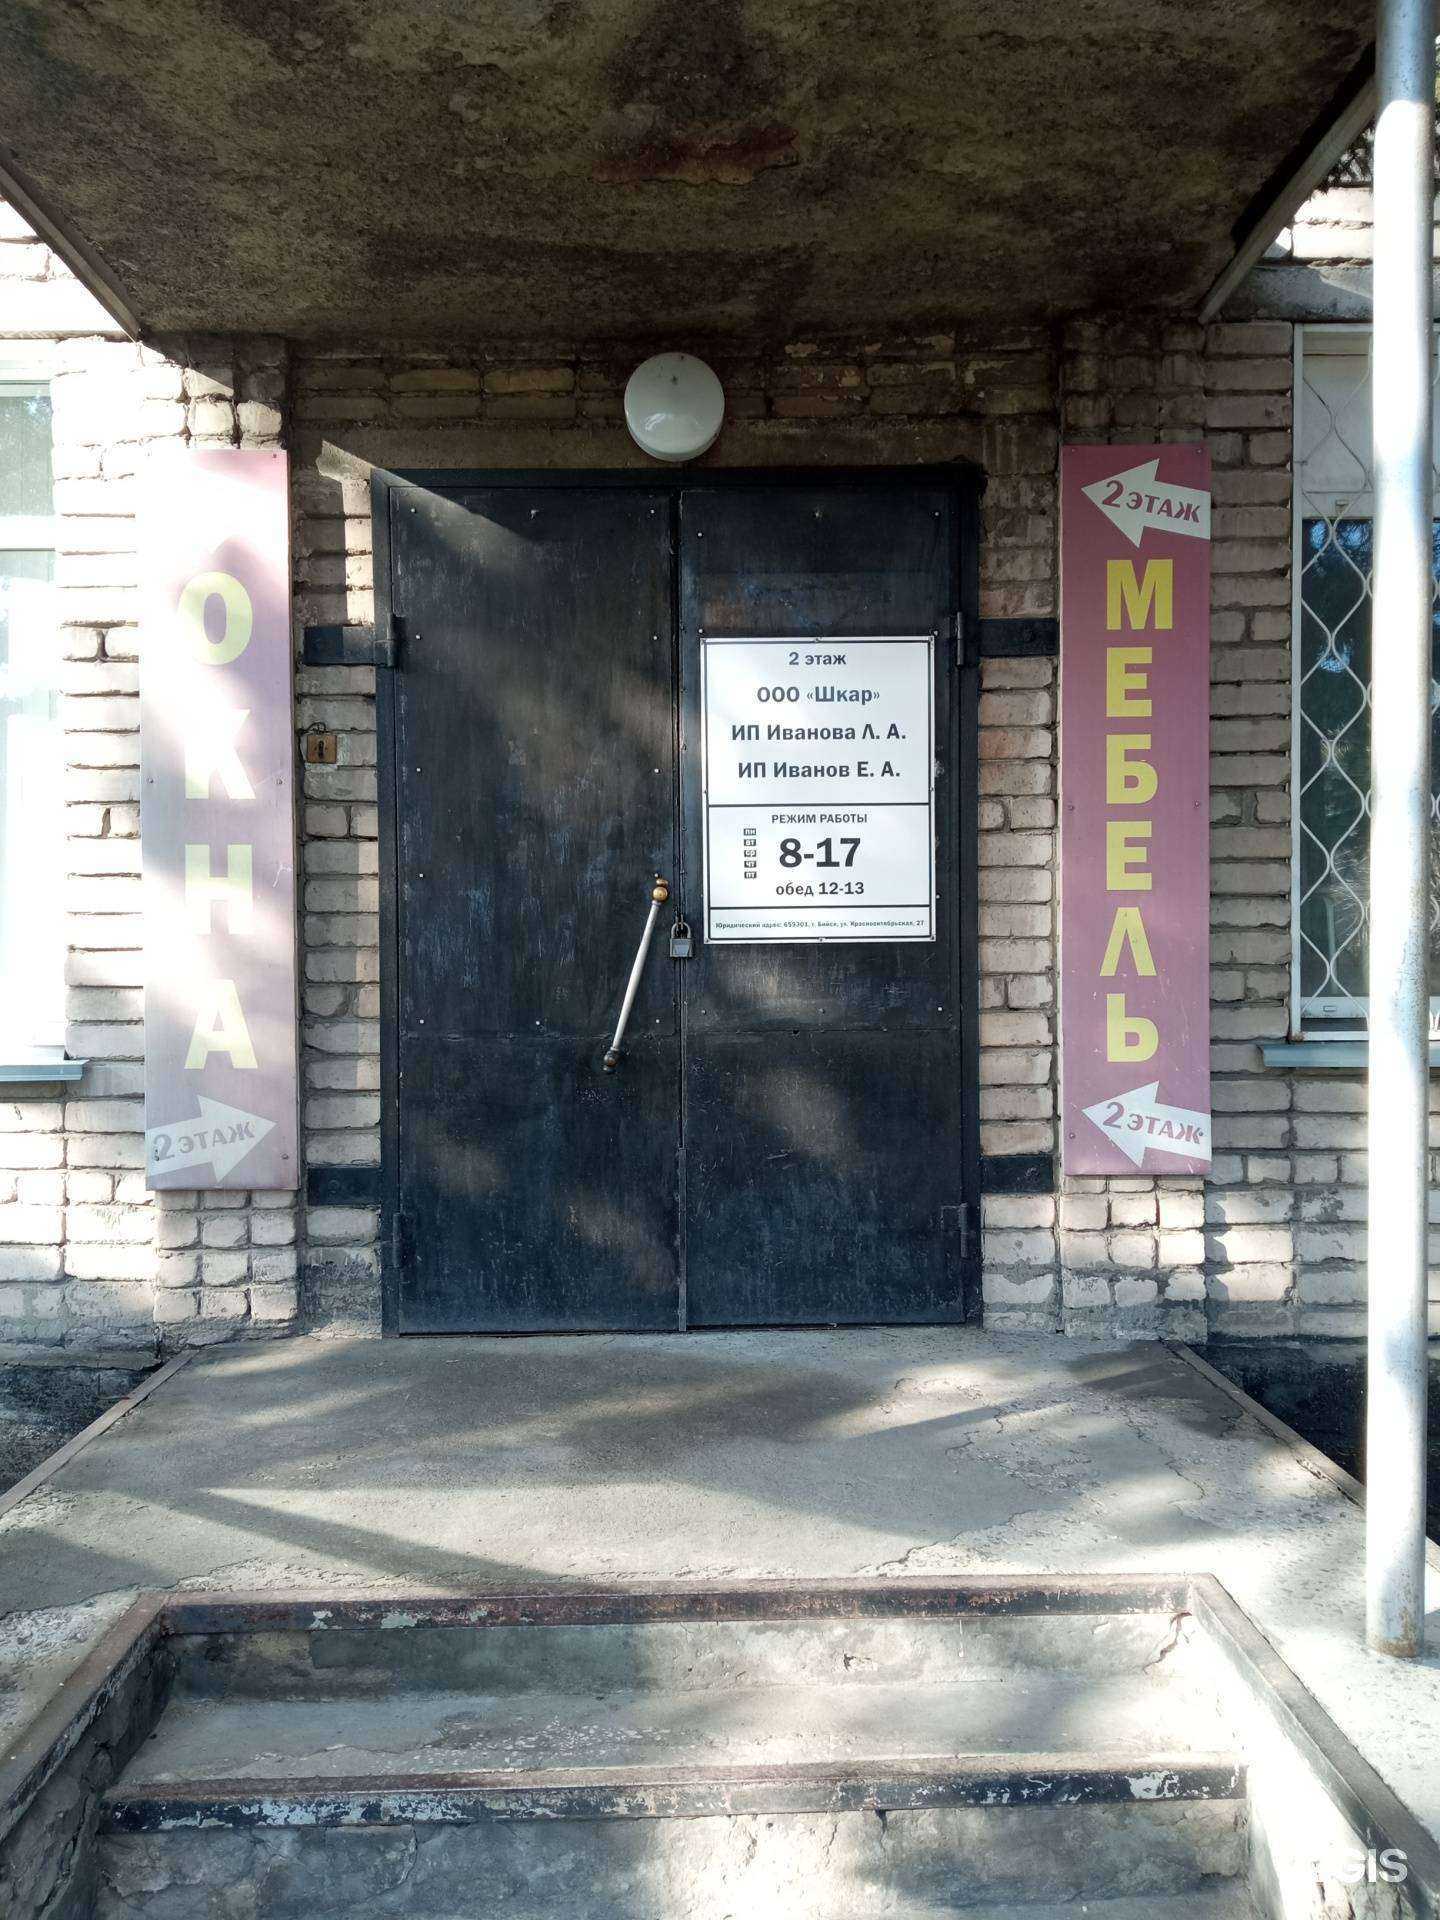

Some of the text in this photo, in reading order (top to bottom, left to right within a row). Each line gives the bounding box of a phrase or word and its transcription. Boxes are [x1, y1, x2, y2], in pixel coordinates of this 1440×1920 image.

[1102, 480, 1200, 523] 2 ЭТАЖ
[788, 651, 847, 666] 2 этаж
[757, 685, 880, 706] ООО «Шкар»
[732, 723, 906, 741] ИП Иванова Л. А.
[738, 760, 900, 778] ИП Иванов Е. А.
[177, 571, 258, 1070] ОКНА
[771, 813, 868, 824] РЕЖИМ РАБОТЫ
[1099, 558, 1174, 1063] МЕБЕЛЬ
[779, 837, 861, 868] 8-17
[775, 881, 865, 897] обед 12-13
[1102, 1101, 1201, 1144] 2 ЭТАЖ
[153, 1121, 255, 1160] 2 ЭТАЖ
